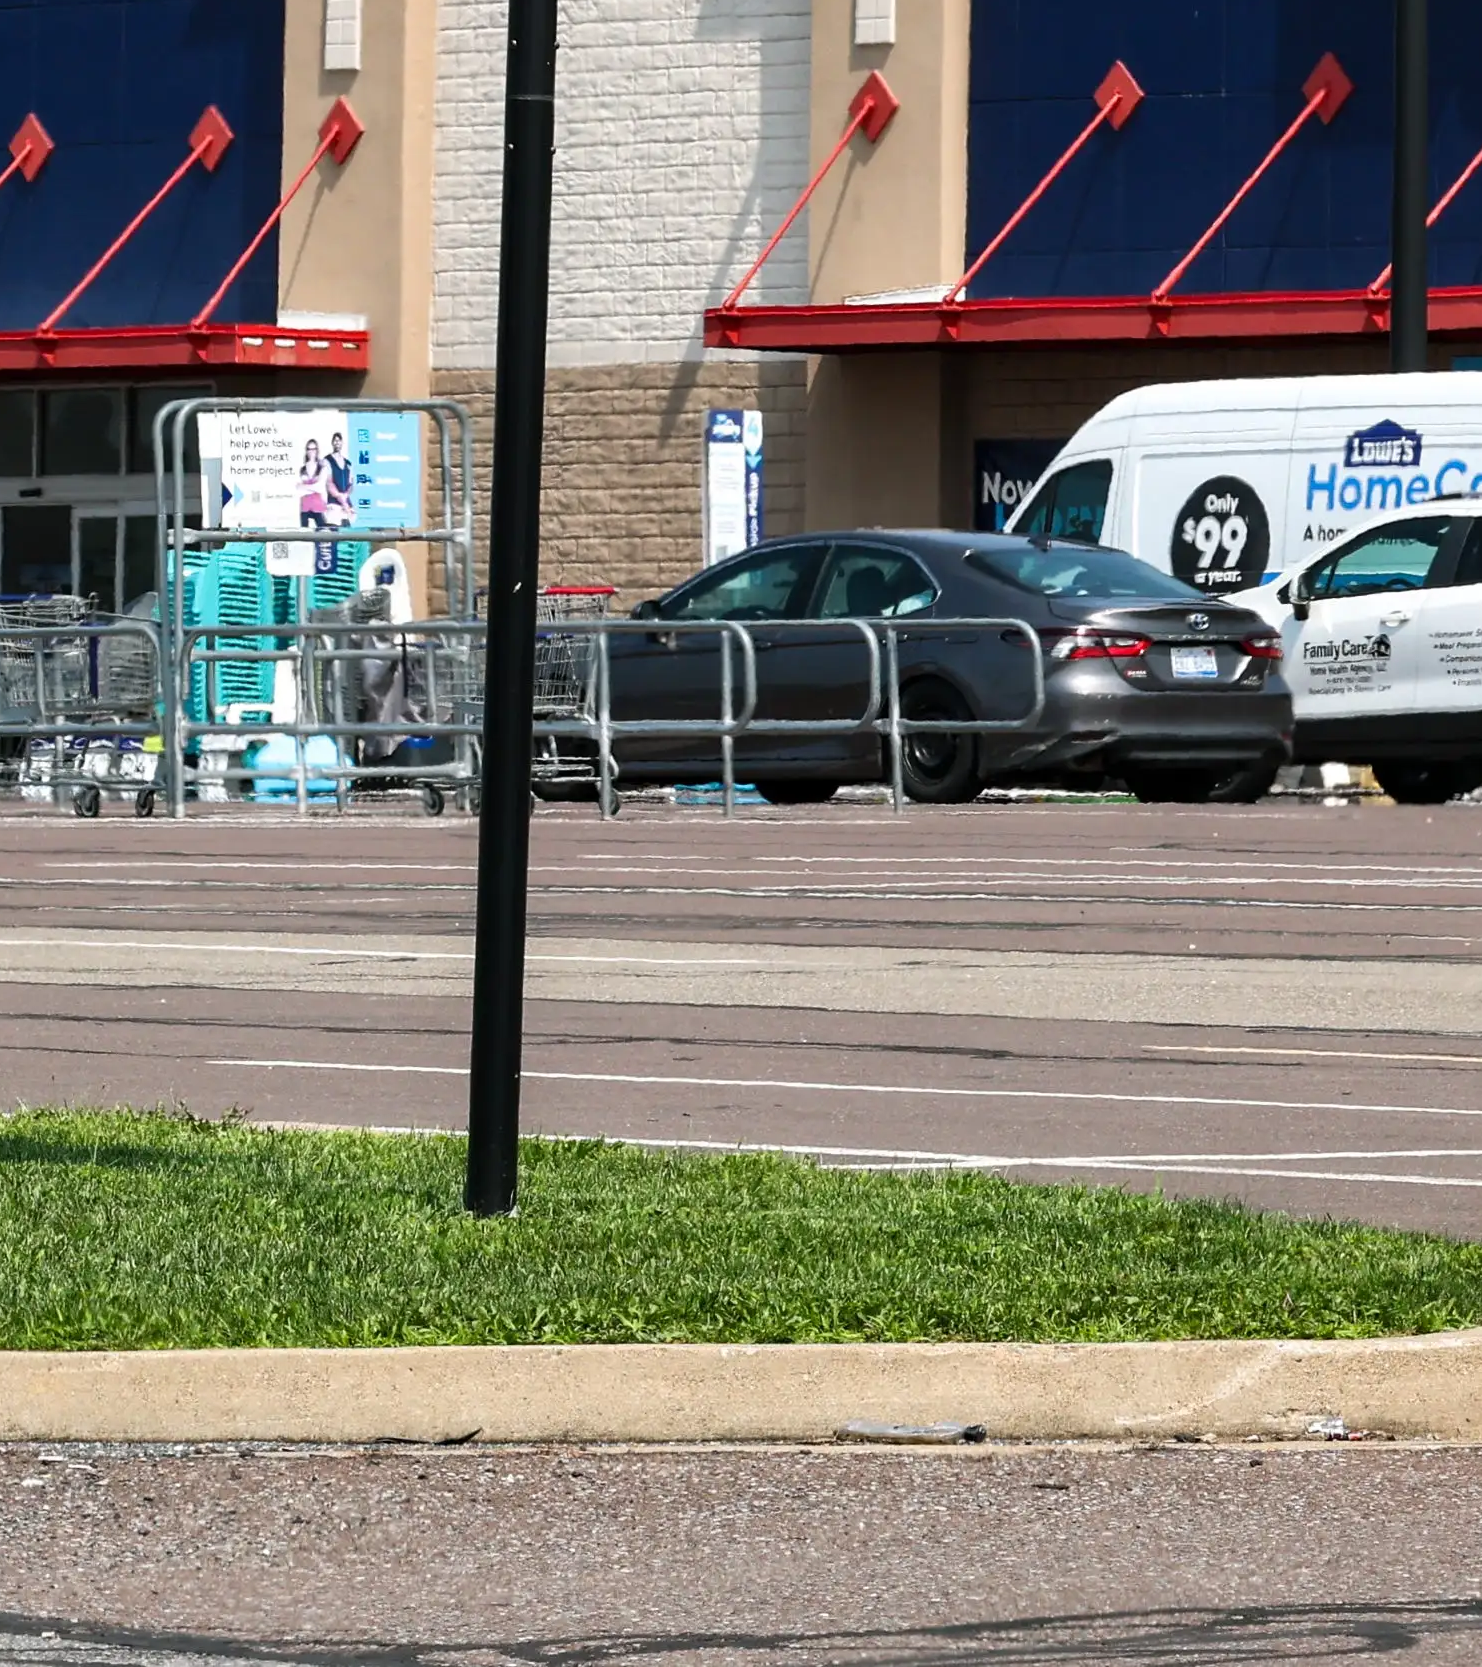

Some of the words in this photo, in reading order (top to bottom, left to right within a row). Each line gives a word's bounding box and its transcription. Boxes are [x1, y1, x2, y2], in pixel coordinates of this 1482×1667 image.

[229, 423, 246, 435] Let
[247, 423, 279, 435] Lowe's
[229, 438, 251, 450] help
[253, 440, 270, 450] you
[272, 438, 293, 449] take
[1350, 437, 1416, 465] LOWE'S
[230, 453, 242, 462] on
[244, 453, 265, 463] your
[267, 452, 290, 463] next
[229, 465, 256, 476] home
[259, 466, 296, 478] project.
[1204, 493, 1239, 516] Only
[1303, 524, 1314, 542] A
[1181, 515, 1248, 569] $99
[1194, 573, 1207, 584] a
[1208, 571, 1243, 586] year.
[1303, 640, 1340, 661] Family
[1341, 639, 1369, 657] Care
